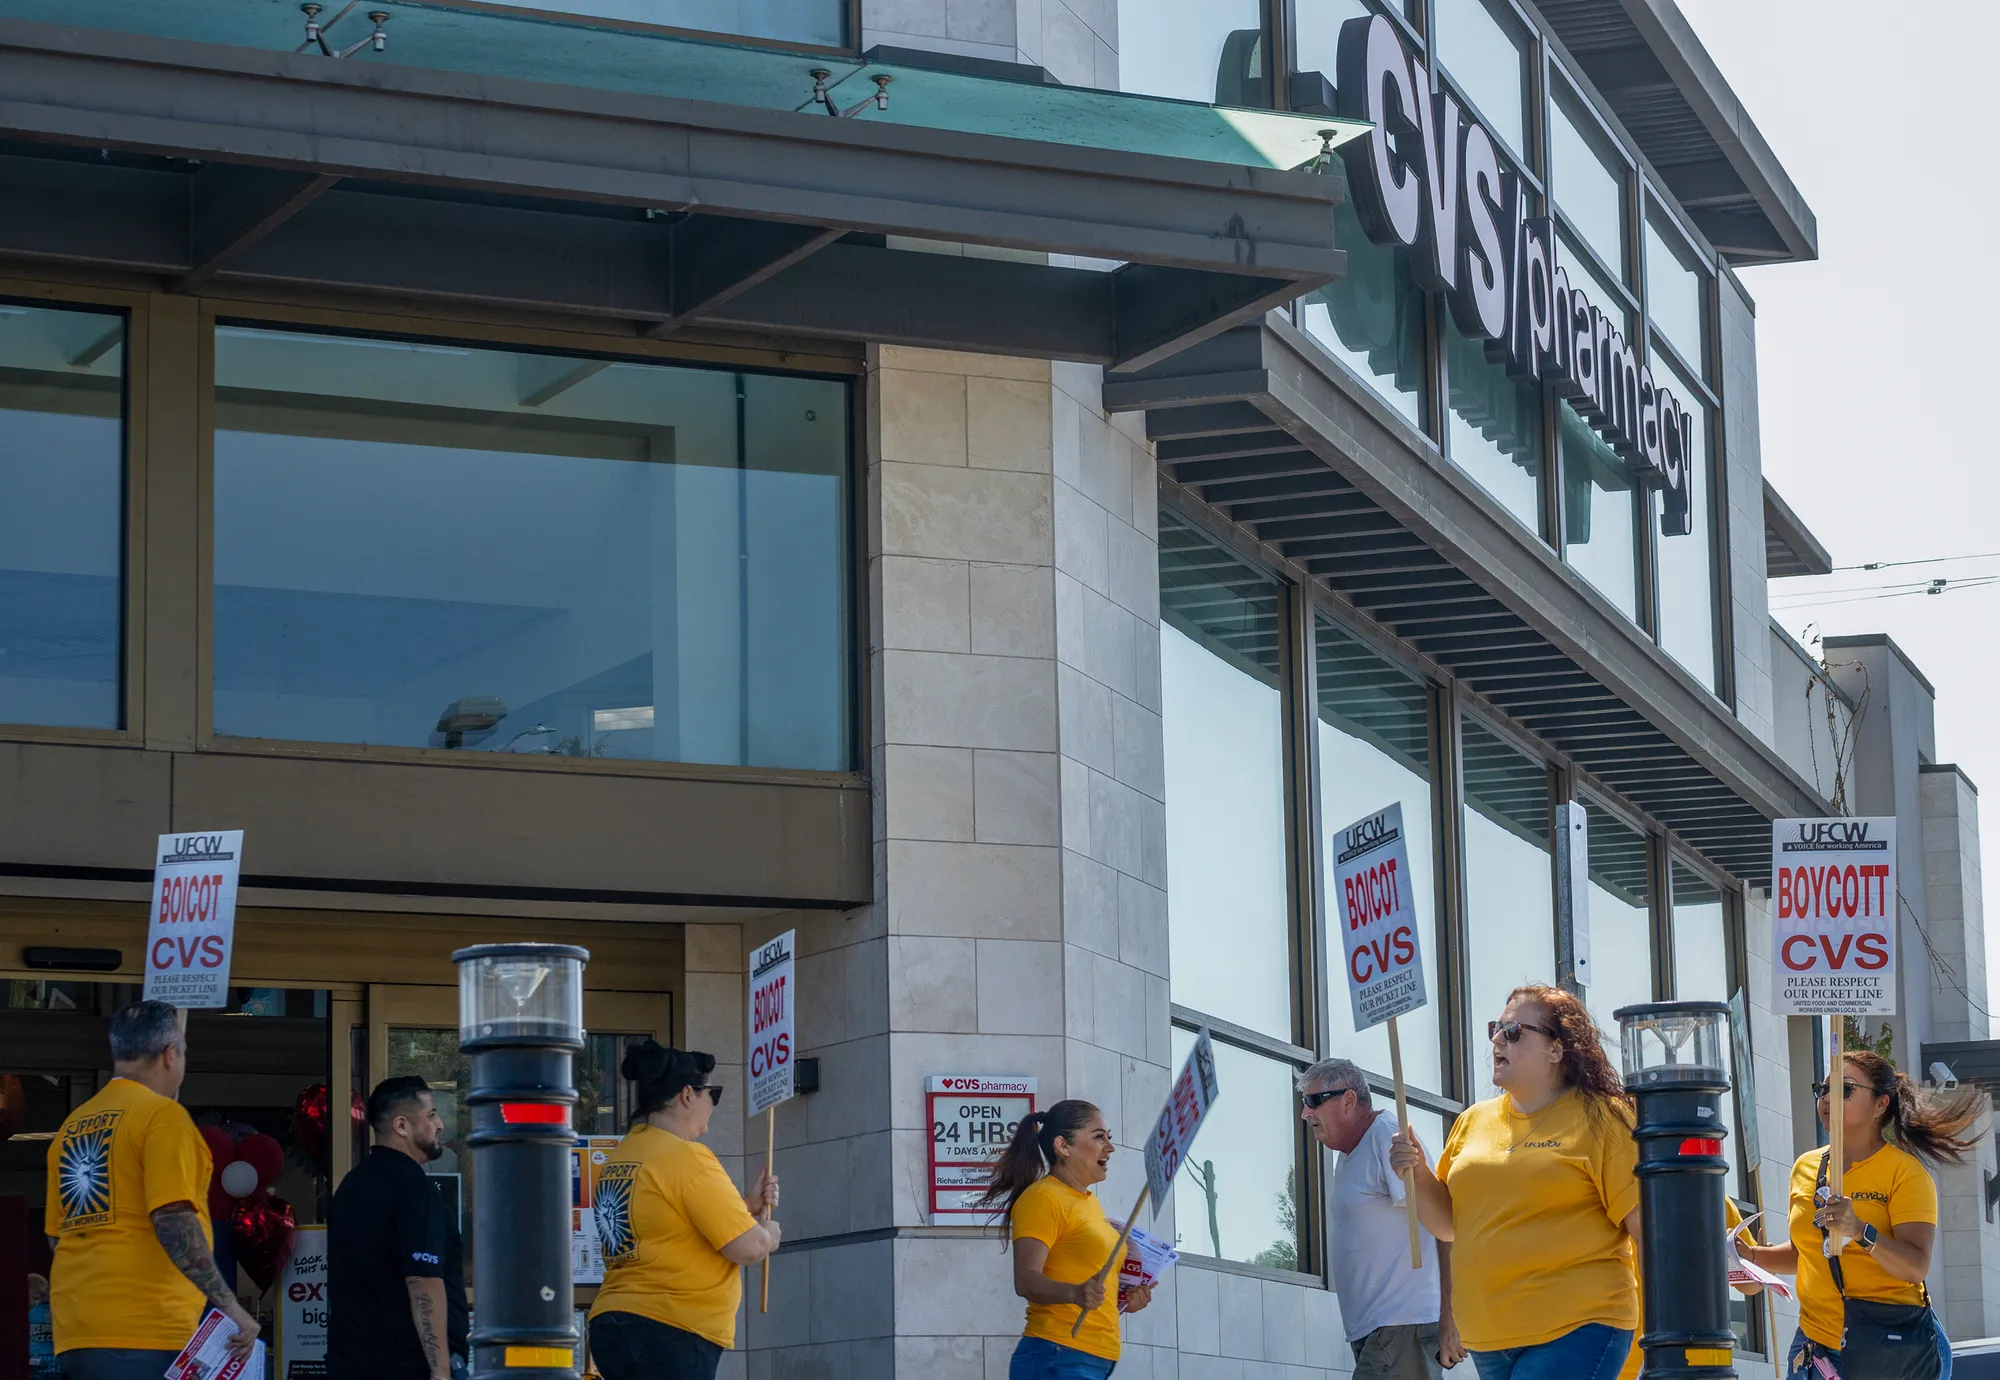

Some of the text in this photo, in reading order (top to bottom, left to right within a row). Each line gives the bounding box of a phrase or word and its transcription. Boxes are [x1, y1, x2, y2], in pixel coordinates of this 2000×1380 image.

[1346, 814, 1384, 849] UFCW
[1799, 822, 1868, 842] UFCW
[175, 836, 222, 855] UFCW
[159, 875, 223, 924] BOICOT
[1344, 858, 1399, 931] BOICOT
[1778, 864, 1889, 919] BOYCOTT
[152, 935, 224, 970] CVS
[759, 939, 783, 967] UFCW
[1351, 926, 1414, 984] CVS
[1781, 933, 1889, 971] CVS
[154, 973, 217, 984] PLEASE RESPECT
[1359, 969, 1412, 1000] PLEASE RESPECT
[1787, 977, 1879, 987] PLEASE RESPECT
[151, 984, 218, 995] OUR PICKET LINE
[1359, 981, 1417, 1013] OUR PICKET LINE
[1784, 989, 1883, 999] OUR PICKET LINE
[754, 976, 786, 1034] BOICOT
[751, 1033, 789, 1078] CVS
[954, 1079, 1027, 1092] CVS pharmacy
[959, 1105, 1001, 1118] OPEN
[64, 1113, 118, 1138] SUPPORT
[934, 1121, 1020, 1143] 24 HRS
[946, 1147, 951, 1155] 7
[954, 1147, 978, 1155] DAYS
[981, 1147, 987, 1155] A
[600, 1165, 637, 1179] UPPORT
[294, 1255, 323, 1266] LOOK
[421, 1252, 439, 1264] CVS
[1126, 1263, 1141, 1273] CVS
[294, 1264, 317, 1275] THIS
